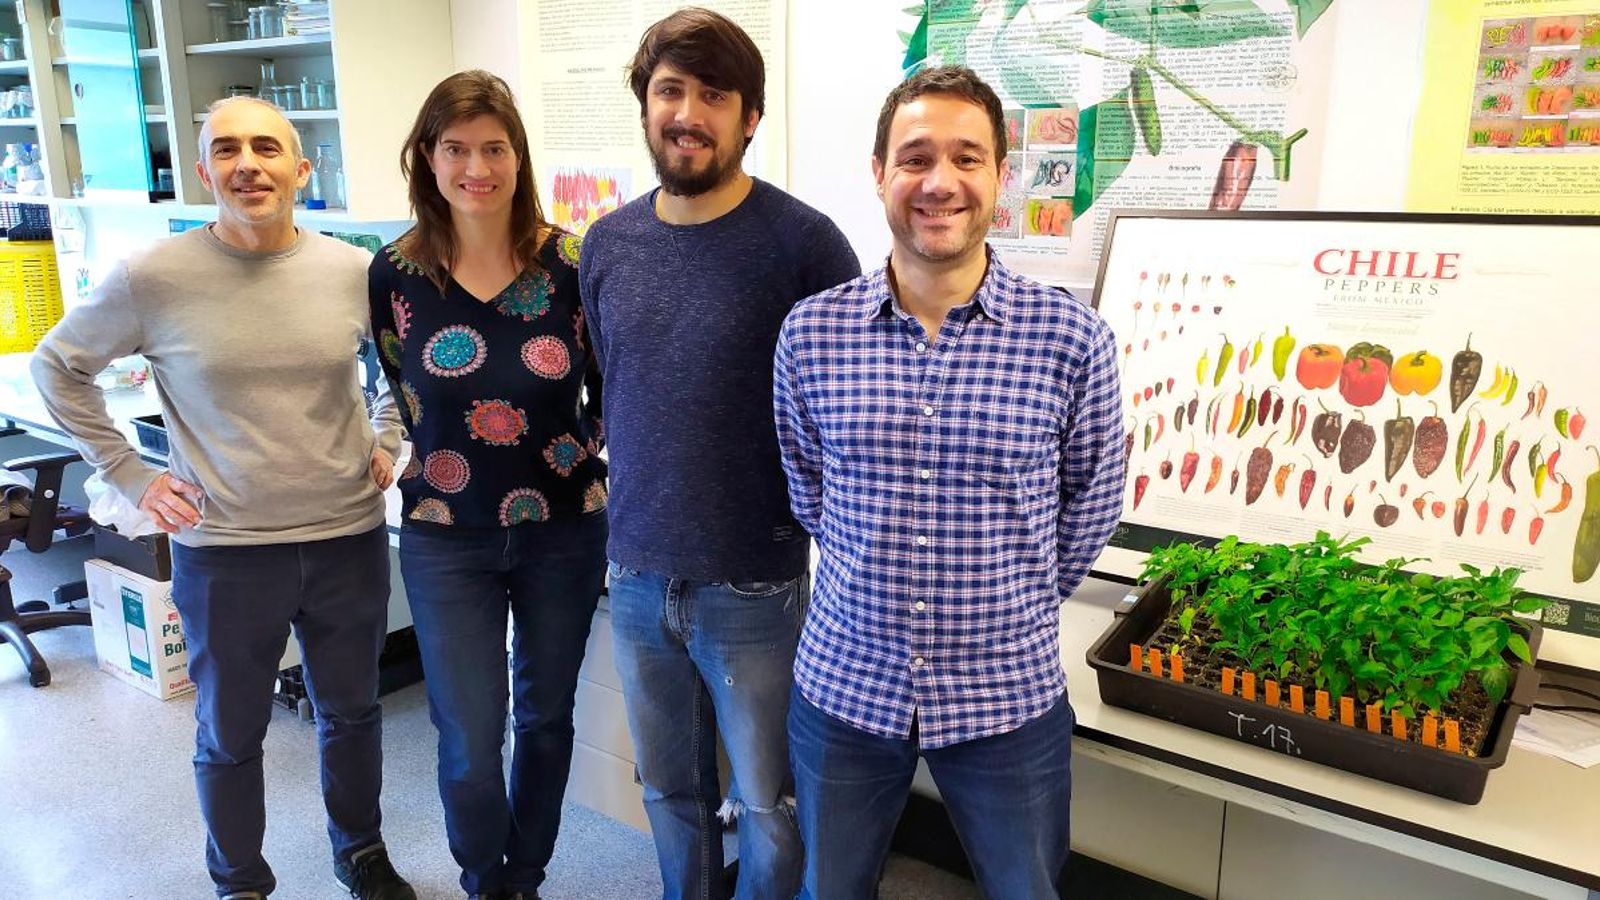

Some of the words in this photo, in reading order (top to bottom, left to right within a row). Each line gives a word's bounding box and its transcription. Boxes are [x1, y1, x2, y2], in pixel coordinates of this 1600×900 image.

[1313, 248, 1461, 280] CHILE
[1323, 278, 1440, 296] PEPPERS
[1333, 295, 1367, 303] FROM
[1374, 296, 1424, 306] MEXICO
